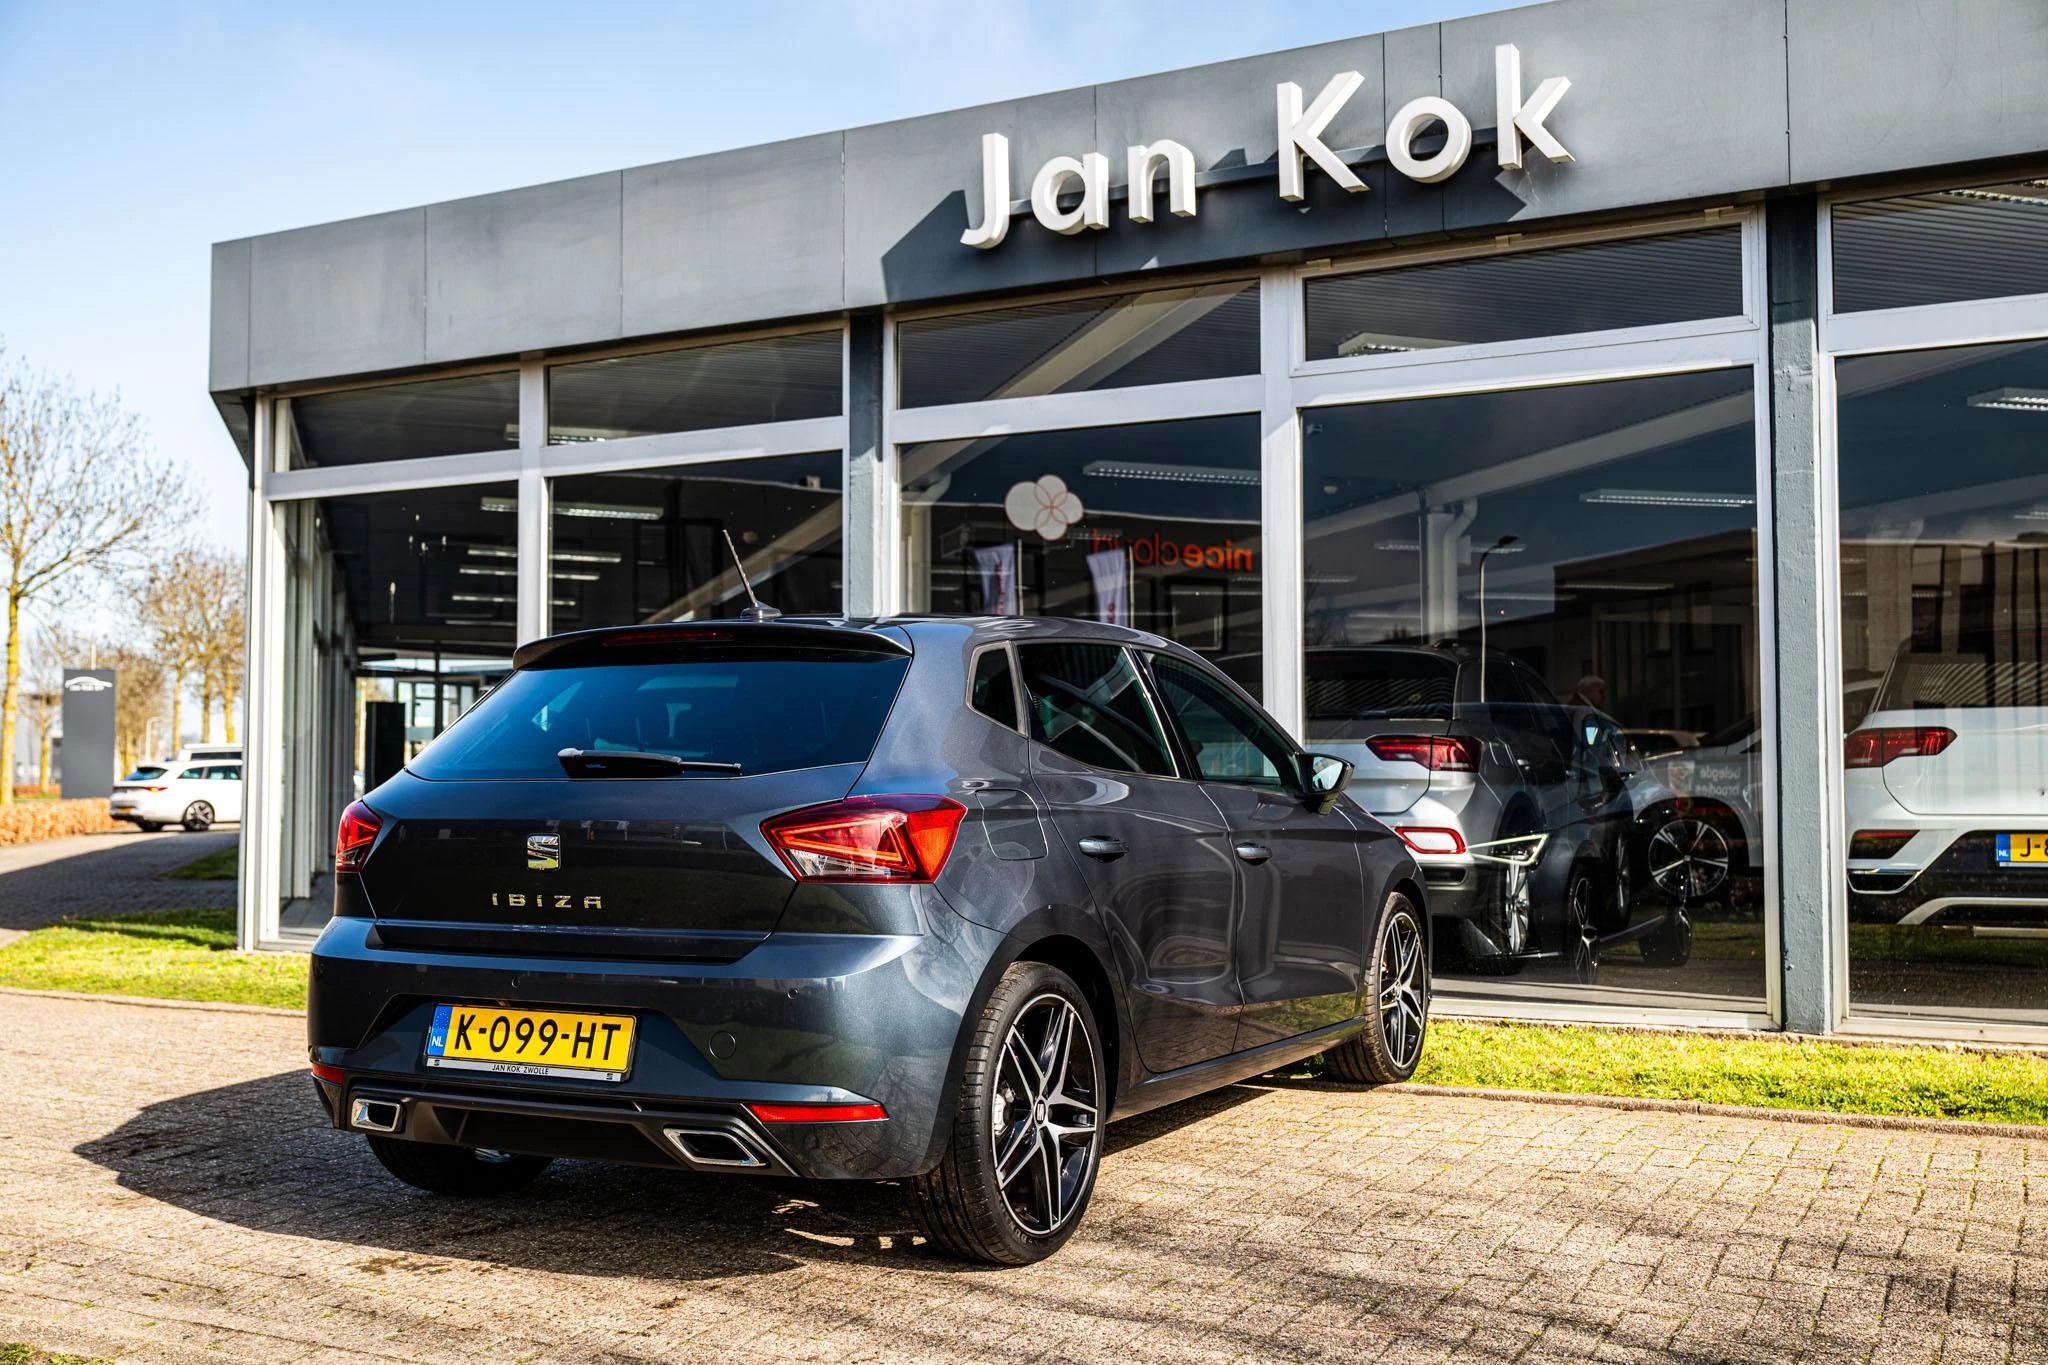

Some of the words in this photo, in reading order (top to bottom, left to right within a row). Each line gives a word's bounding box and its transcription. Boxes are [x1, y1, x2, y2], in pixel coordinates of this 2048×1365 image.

[960, 131, 1197, 250] Jan
[1276, 43, 1576, 203] Kok
[1998, 849, 2009, 857] NL
[492, 892, 602, 909] IBIZA
[431, 1035, 444, 1048] NL
[454, 1013, 622, 1061] K-099-HT
[492, 1064, 505, 1072] JAN
[507, 1065, 520, 1073] KOK
[524, 1066, 549, 1075] ZWOLLE
